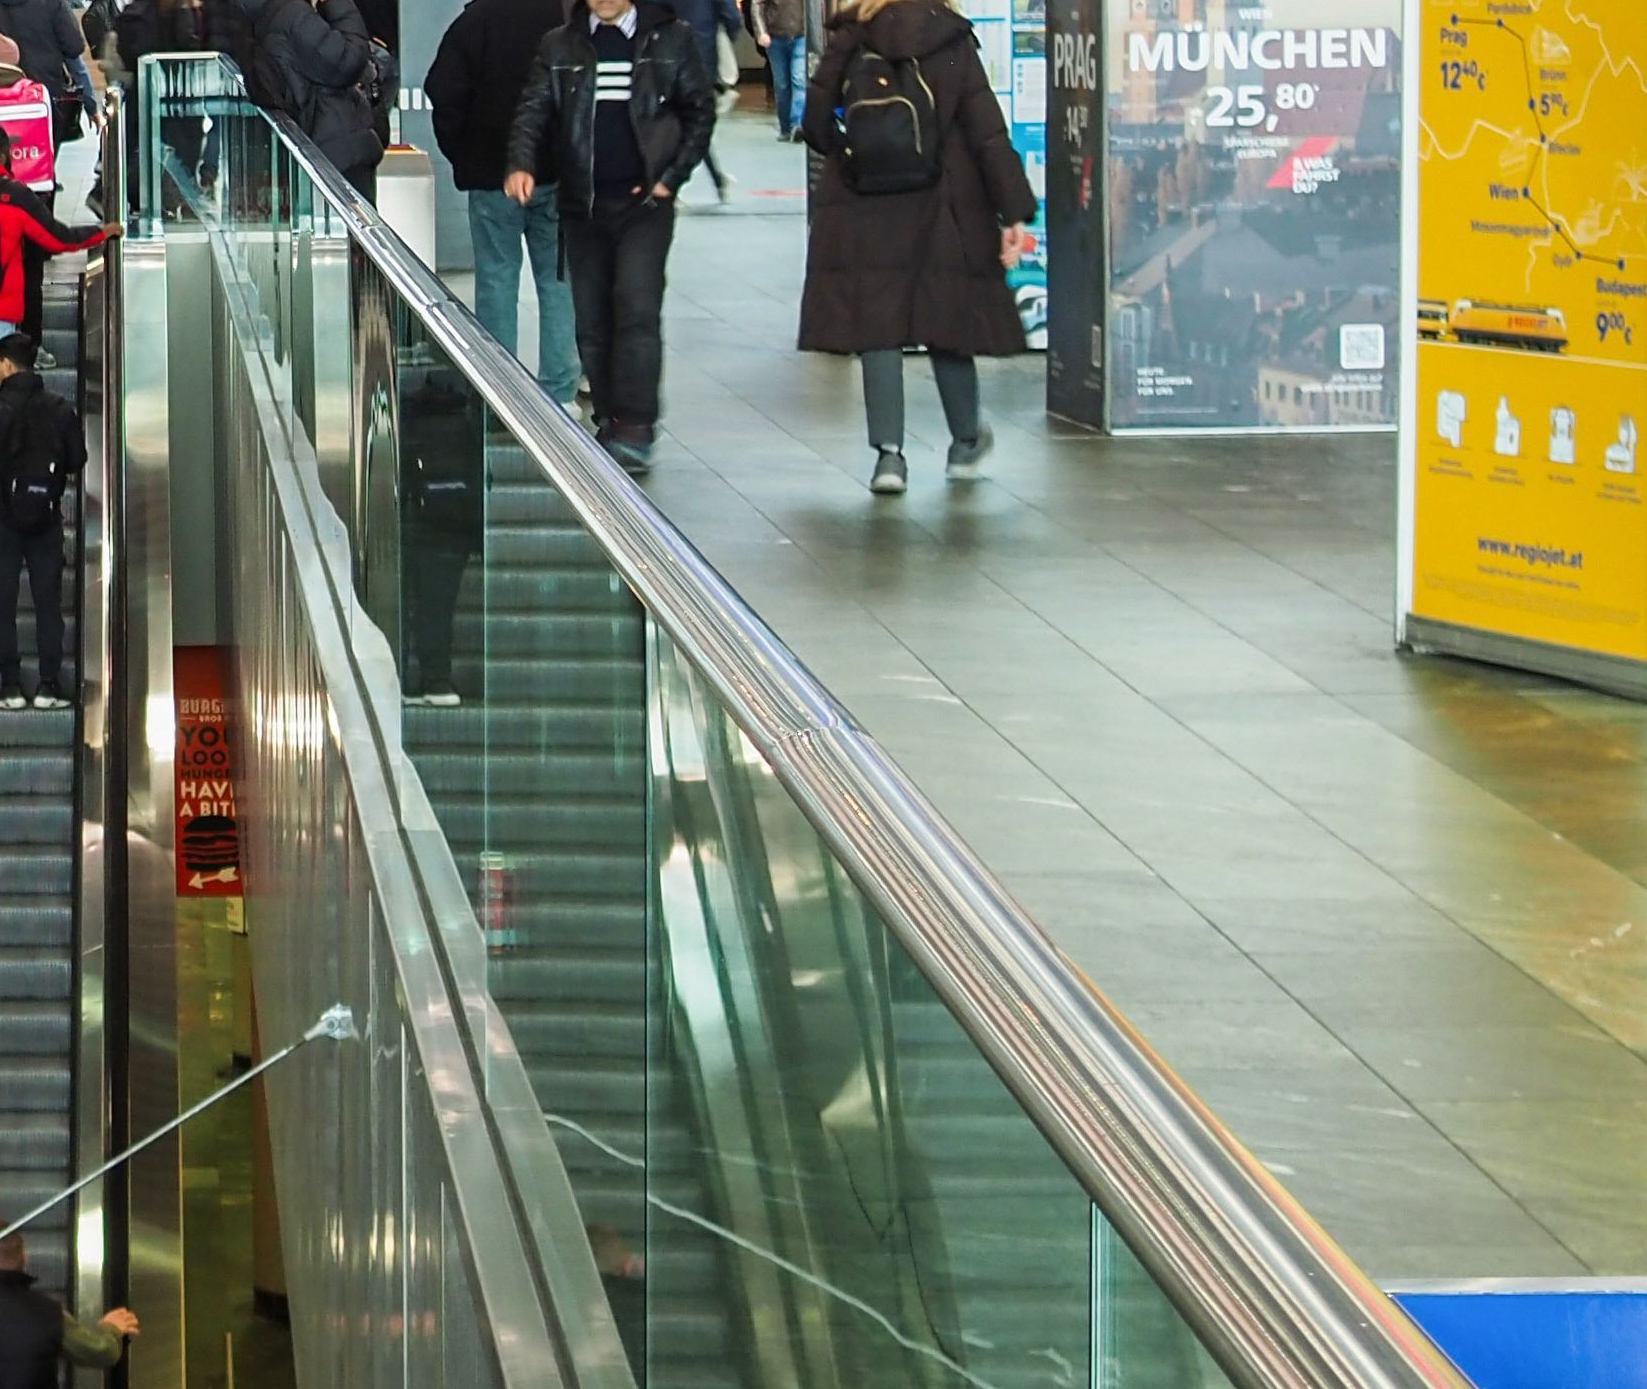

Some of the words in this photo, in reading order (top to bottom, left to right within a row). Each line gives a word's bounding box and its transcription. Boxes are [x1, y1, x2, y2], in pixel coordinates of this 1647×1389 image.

[1238, 7, 1274, 21] WIEN
[1440, 27, 1468, 48] Prag
[1129, 23, 1386, 72] MÜNCHEN
[1055, 33, 1096, 91] PRAG
[1489, 183, 1519, 201] Wien
[1477, 536, 1583, 570] www.regiojet.at
[180, 699, 226, 715] BURG
[180, 727, 228, 748] YO
[181, 750, 227, 766] LOO
[180, 802, 194, 817] A
